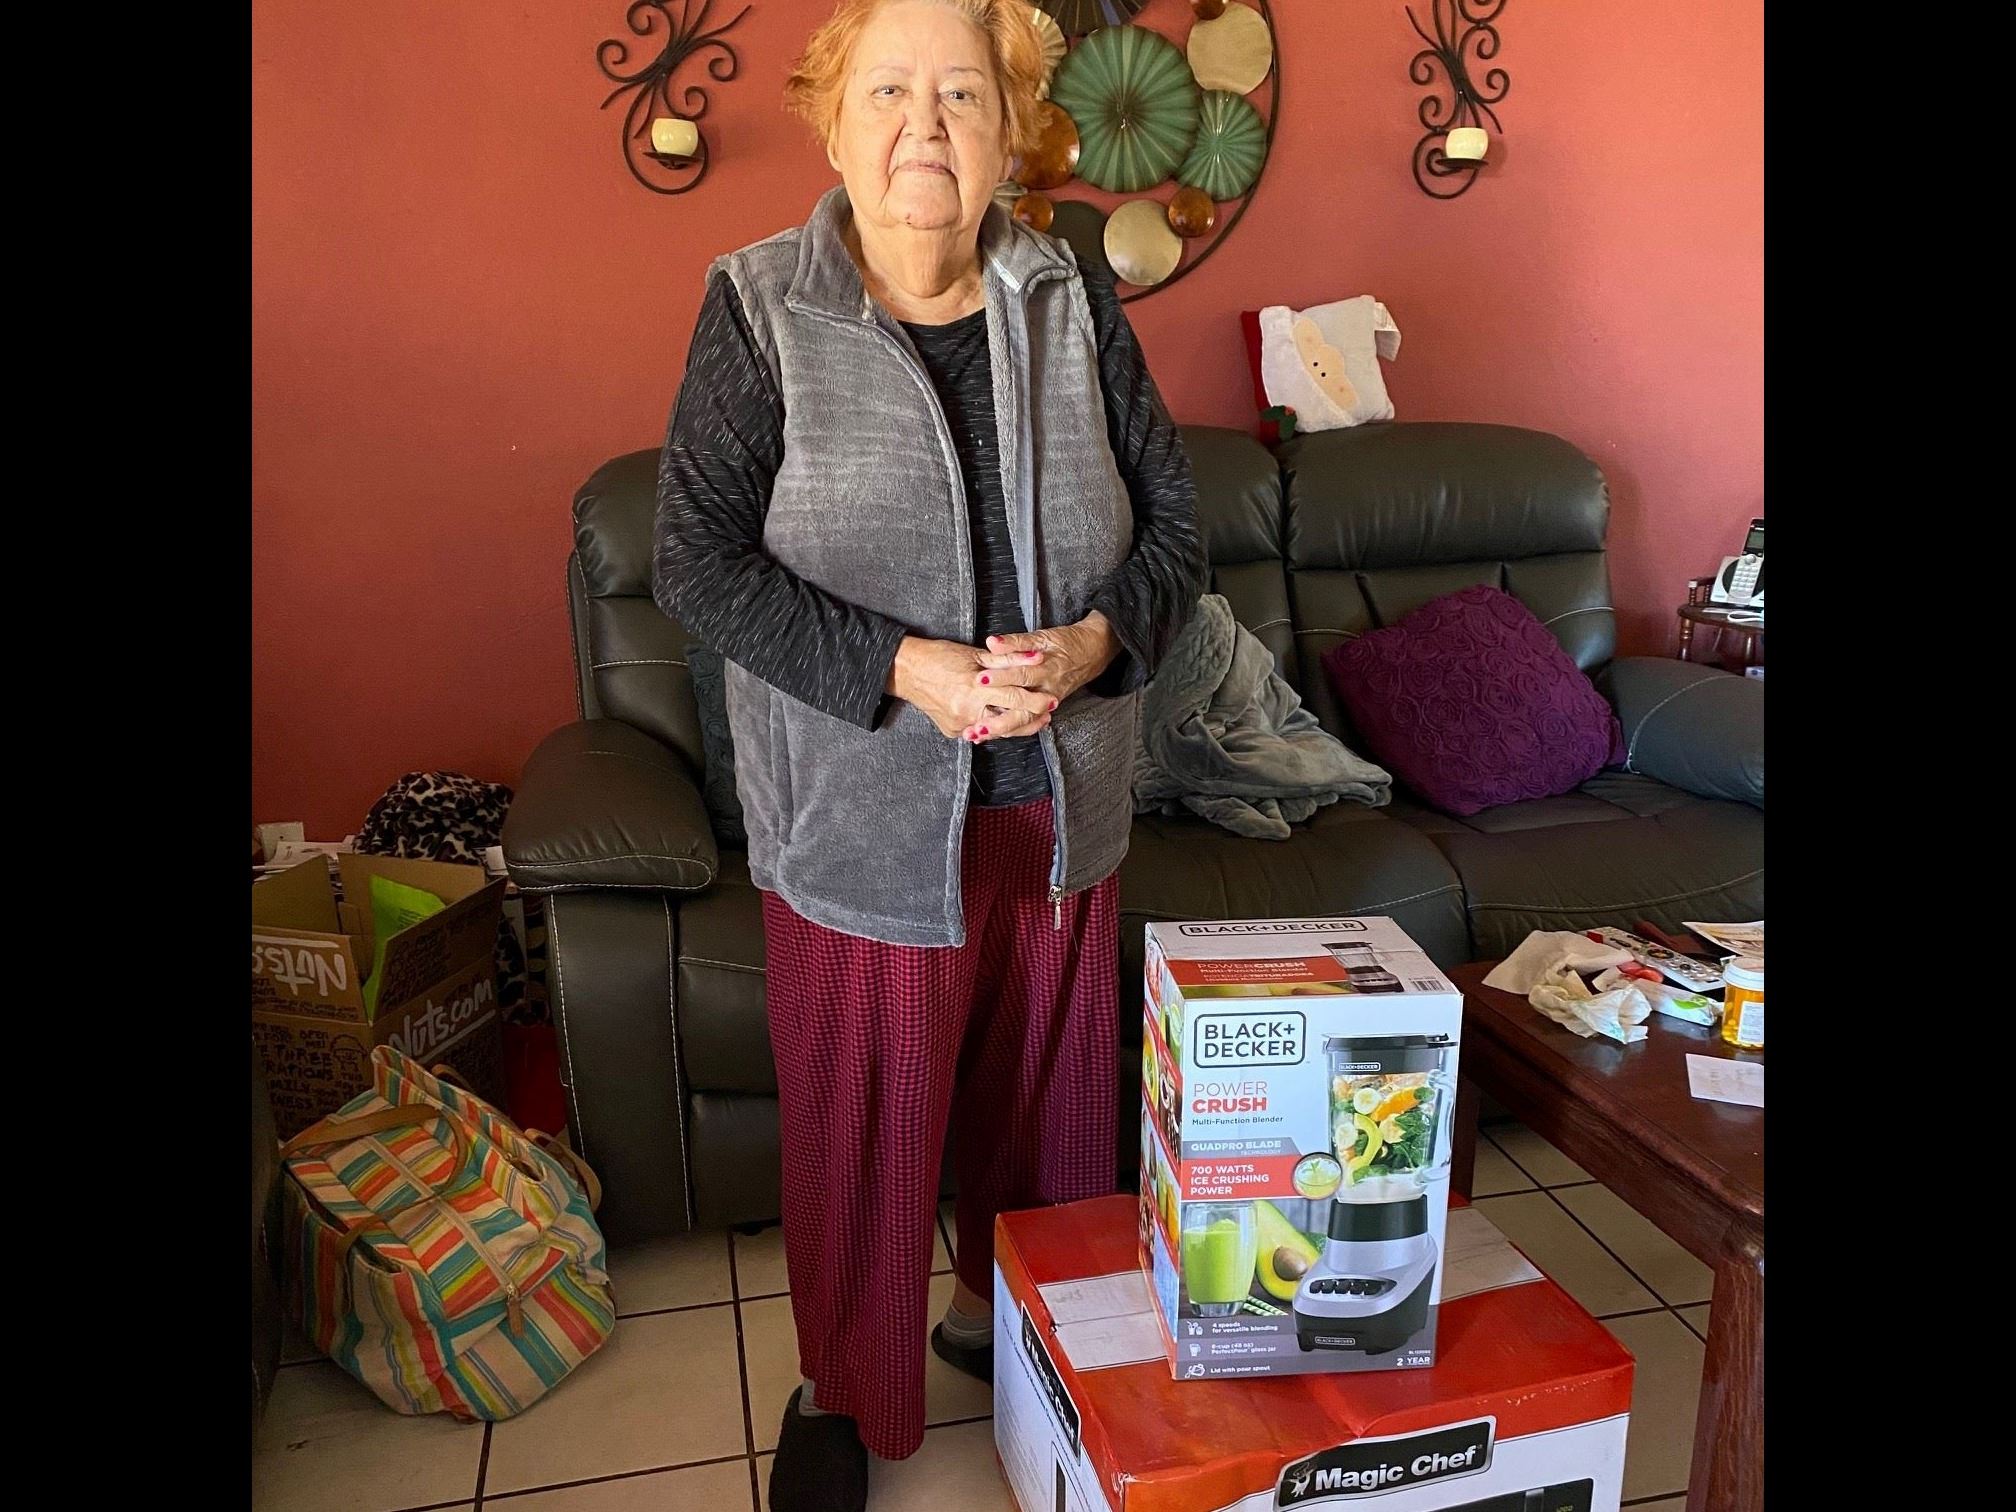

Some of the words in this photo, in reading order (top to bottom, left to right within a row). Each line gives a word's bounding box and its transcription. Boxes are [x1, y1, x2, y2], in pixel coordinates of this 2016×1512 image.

[1189, 922, 1356, 934] BLACK+DECKER
[1204, 1022, 1296, 1040] BLACK+
[1204, 1040, 1296, 1058] DECKER
[1194, 1081, 1268, 1097] POWER
[1192, 1097, 1267, 1114] CRUSH
[1192, 1117, 1250, 1125] Multi-Function
[1191, 1142, 1244, 1151] QUADPRO
[1246, 1140, 1281, 1149] BLADE
[1191, 1166, 1212, 1175] 700
[1216, 1164, 1254, 1173] WATTS
[1190, 1176, 1208, 1185] ICE
[1212, 1174, 1270, 1184] CRUSHING
[1190, 1186, 1232, 1195] POWER
[1397, 1358, 1403, 1366] 2
[1407, 1356, 1430, 1364] YEAR
[1315, 1463, 1404, 1491] Magic
[1411, 1444, 1476, 1477] Chef
